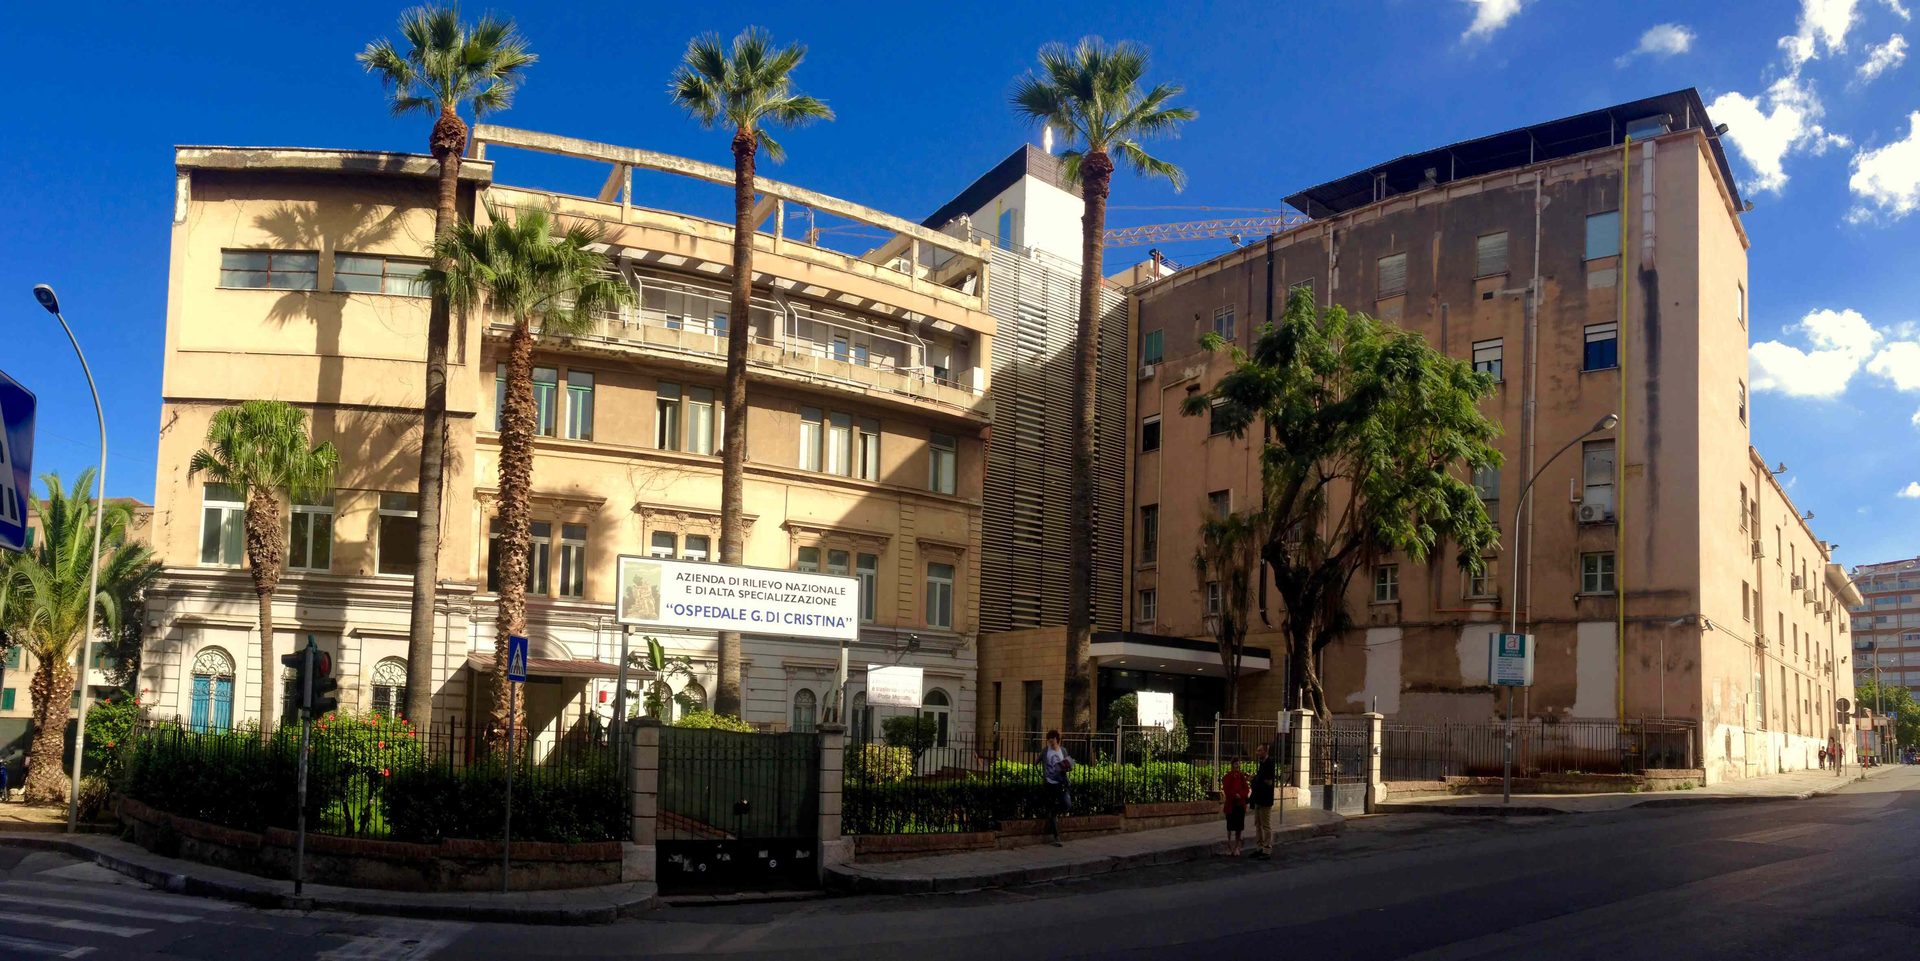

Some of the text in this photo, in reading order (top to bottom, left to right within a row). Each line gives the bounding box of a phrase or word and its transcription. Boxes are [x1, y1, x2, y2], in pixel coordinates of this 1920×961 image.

[676, 572, 847, 596] AZIENDA DI RILIEVO NAZIONALE
[685, 585, 837, 607] E DI ALTA SPECIALIZZAZIONE
[666, 602, 852, 629] “OSPEDALE G. DI CRISTINA”
